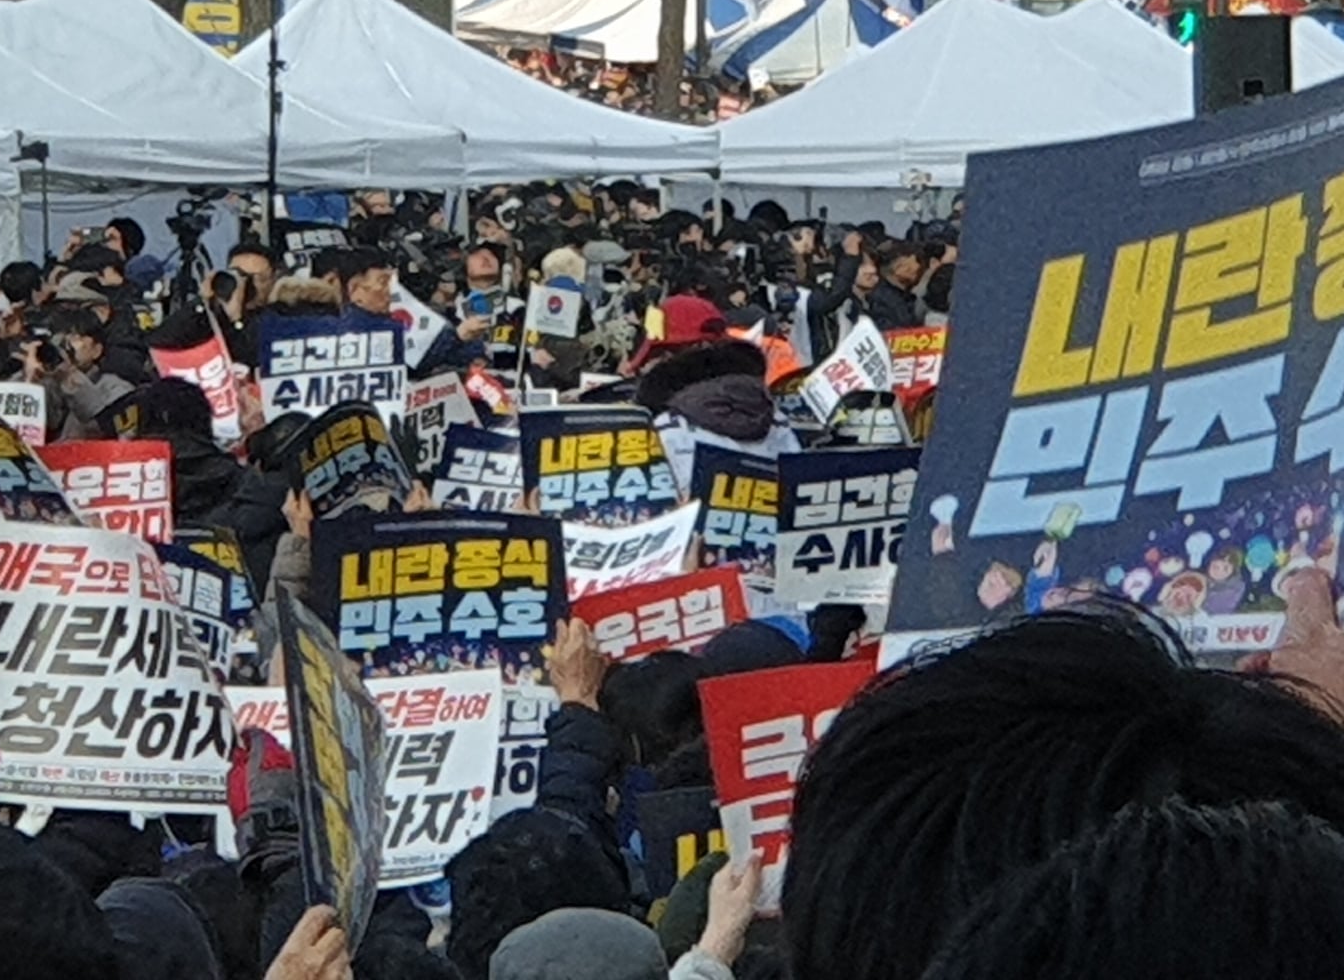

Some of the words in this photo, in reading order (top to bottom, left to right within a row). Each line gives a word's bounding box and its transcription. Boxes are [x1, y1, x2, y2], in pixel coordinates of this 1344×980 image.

[1012, 191, 1308, 398] 내란
[269, 330, 396, 373] 김건희를
[539, 431, 615, 474] 내란
[967, 352, 1286, 538] 민주
[54, 458, 169, 508] 우국힘
[340, 541, 450, 600] 내란
[453, 538, 549, 592] 종식
[340, 594, 444, 651] 민주
[449, 586, 548, 642] 수호
[593, 583, 726, 659] 우국힘
